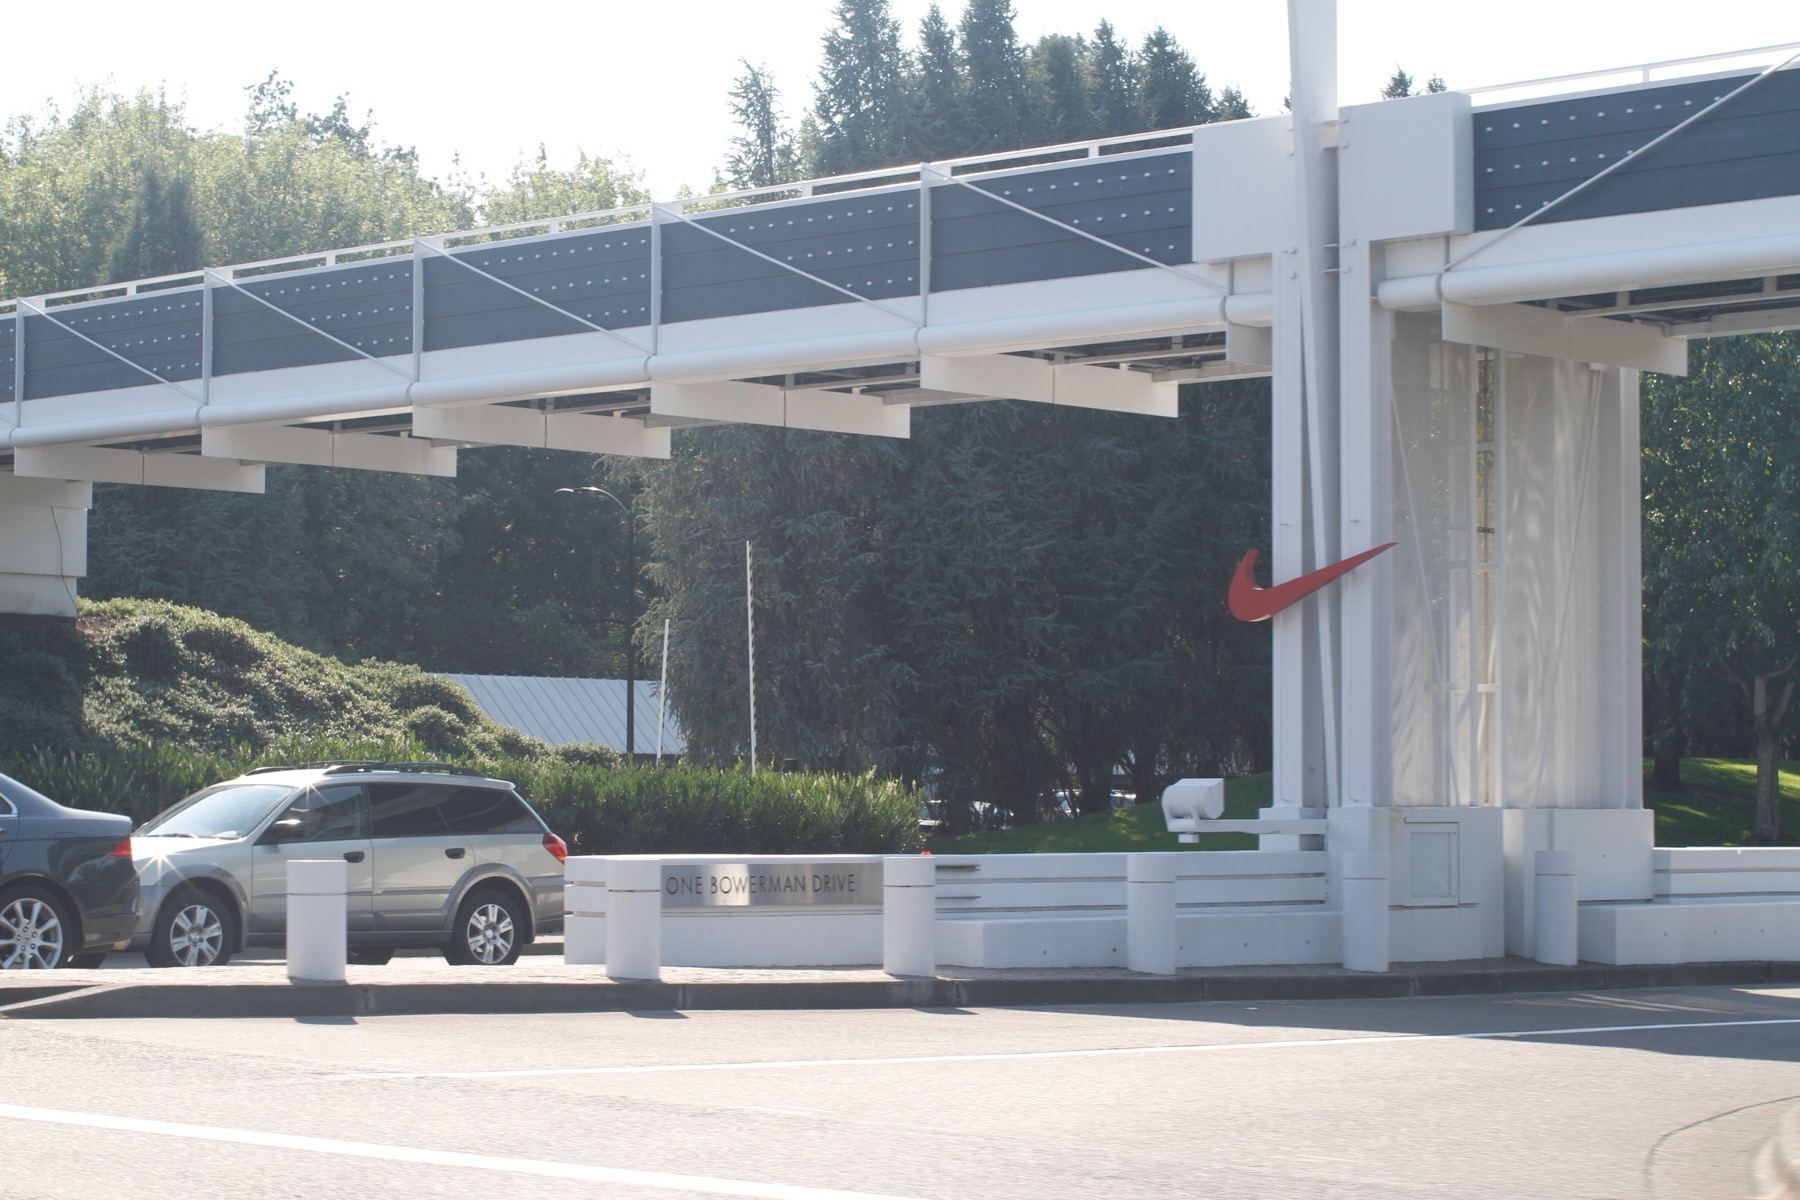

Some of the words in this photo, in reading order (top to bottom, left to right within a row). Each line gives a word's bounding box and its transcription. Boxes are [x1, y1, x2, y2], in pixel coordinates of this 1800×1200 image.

[665, 876, 703, 895] ONE
[710, 875, 807, 894] BOWERMAN
[812, 874, 855, 893] DRIVE
